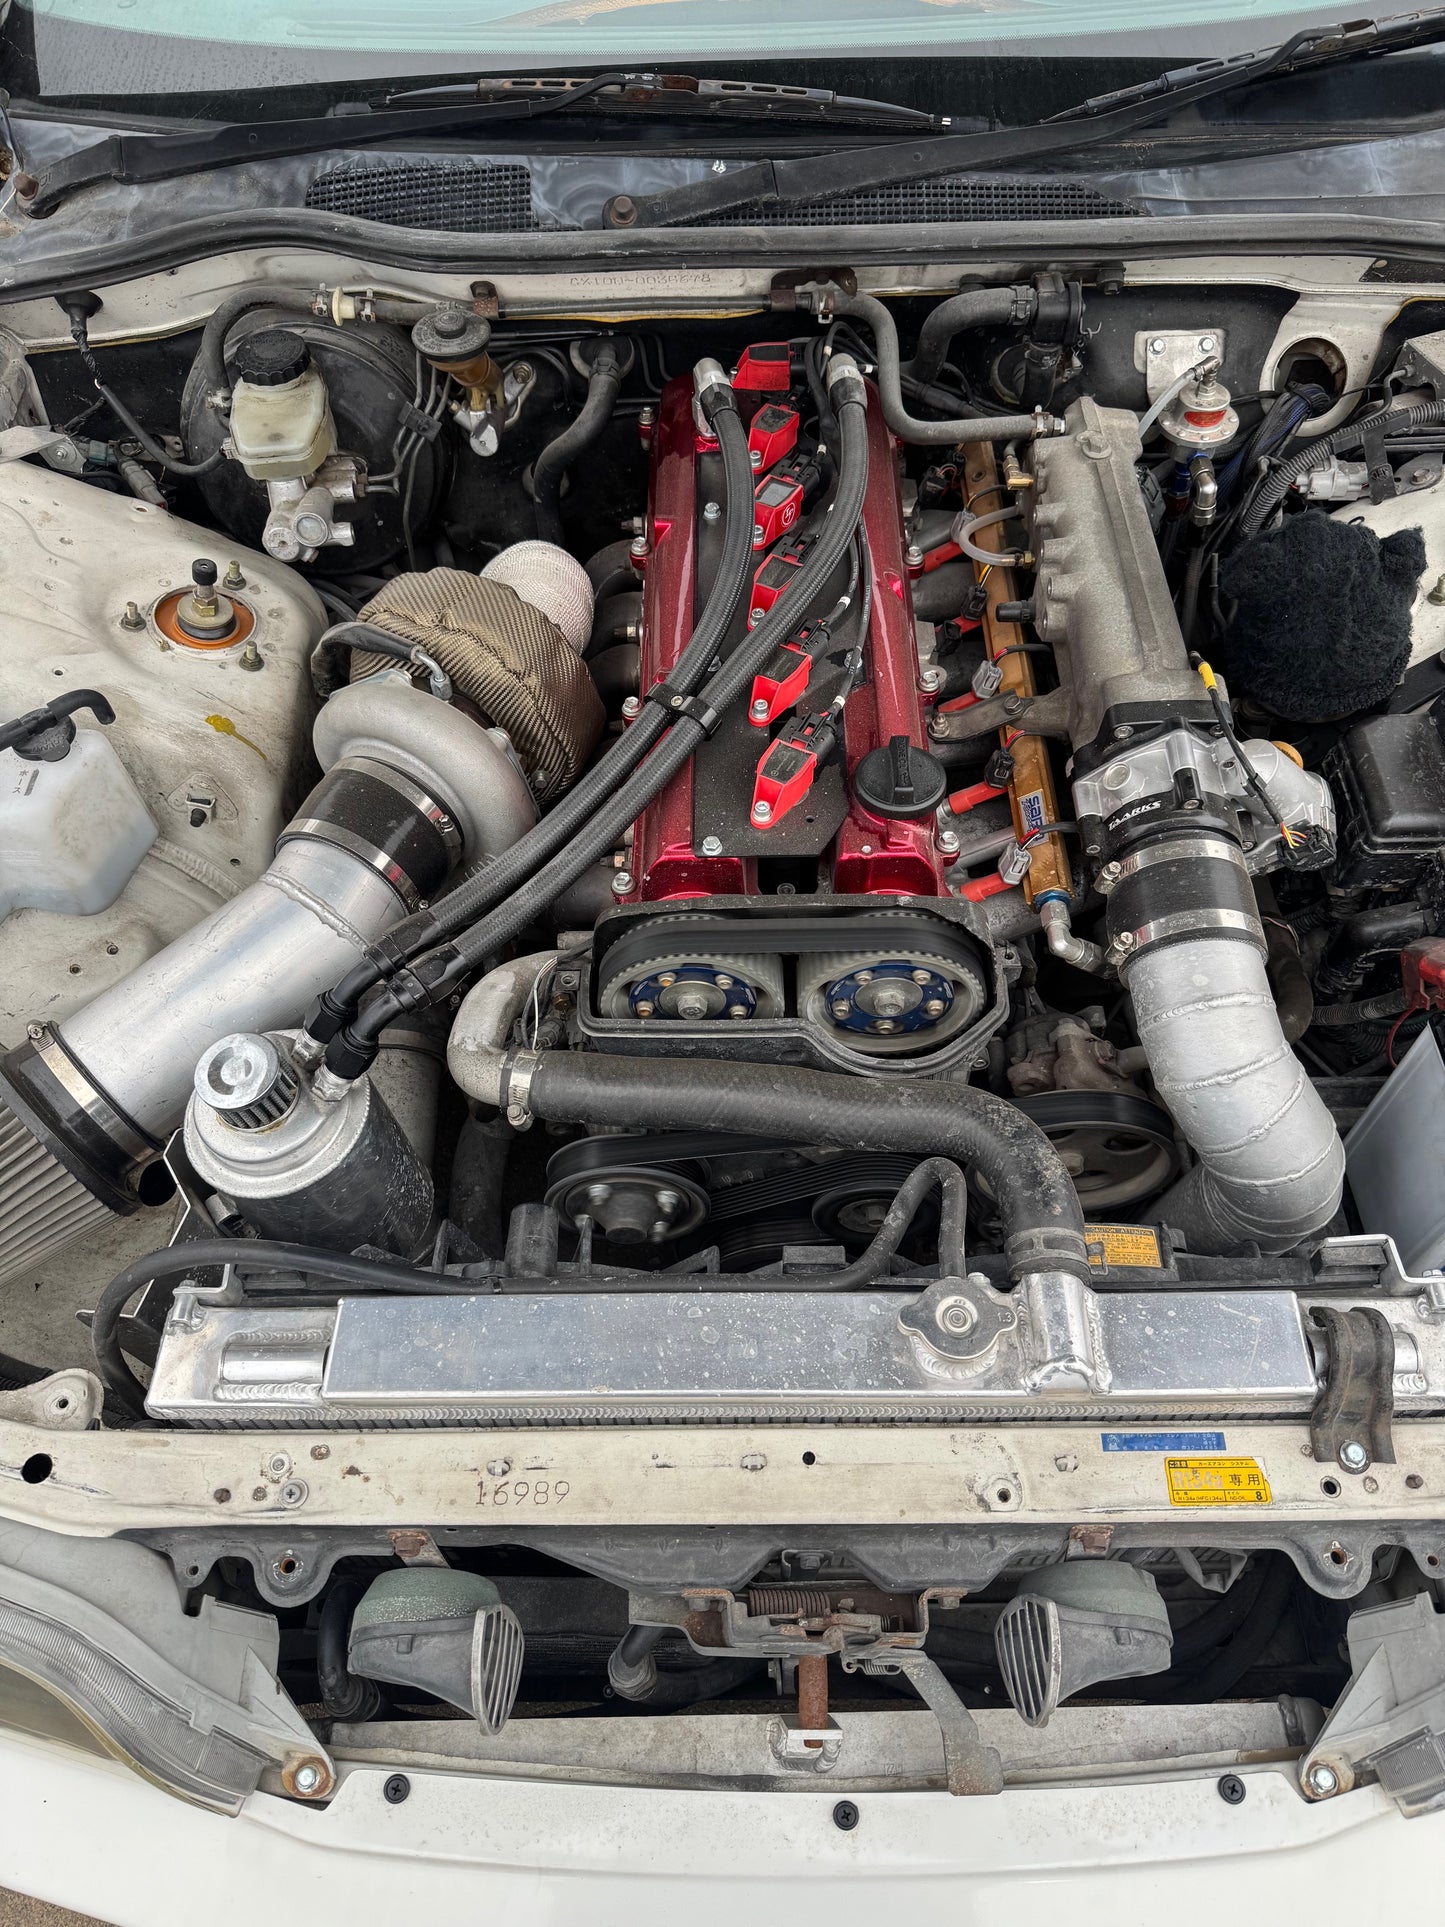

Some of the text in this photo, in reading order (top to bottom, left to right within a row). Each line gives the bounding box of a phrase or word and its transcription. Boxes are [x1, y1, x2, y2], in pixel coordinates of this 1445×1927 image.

[997, 1312, 1012, 1322] 1.3
[475, 1480, 570, 1506] 16989
[1255, 1490, 1263, 1501] 8
